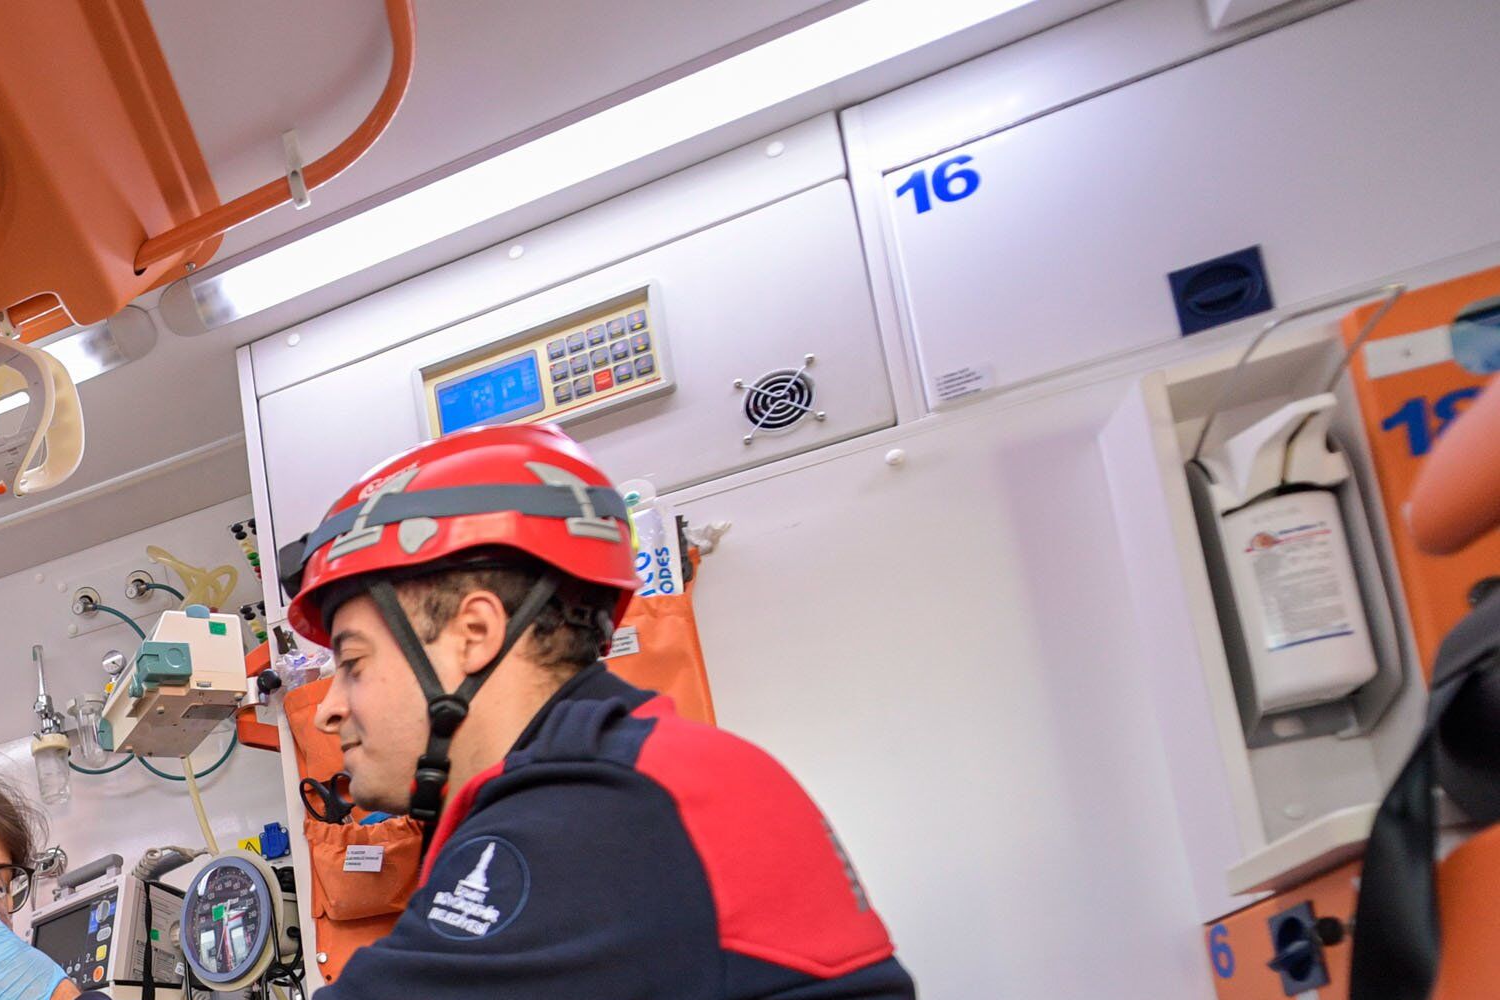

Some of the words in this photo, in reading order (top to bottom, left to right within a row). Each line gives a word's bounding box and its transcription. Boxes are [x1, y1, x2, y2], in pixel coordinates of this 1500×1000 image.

[896, 155, 980, 214] 16
[655, 547, 675, 594] ODES
[1209, 923, 1235, 979] 6
